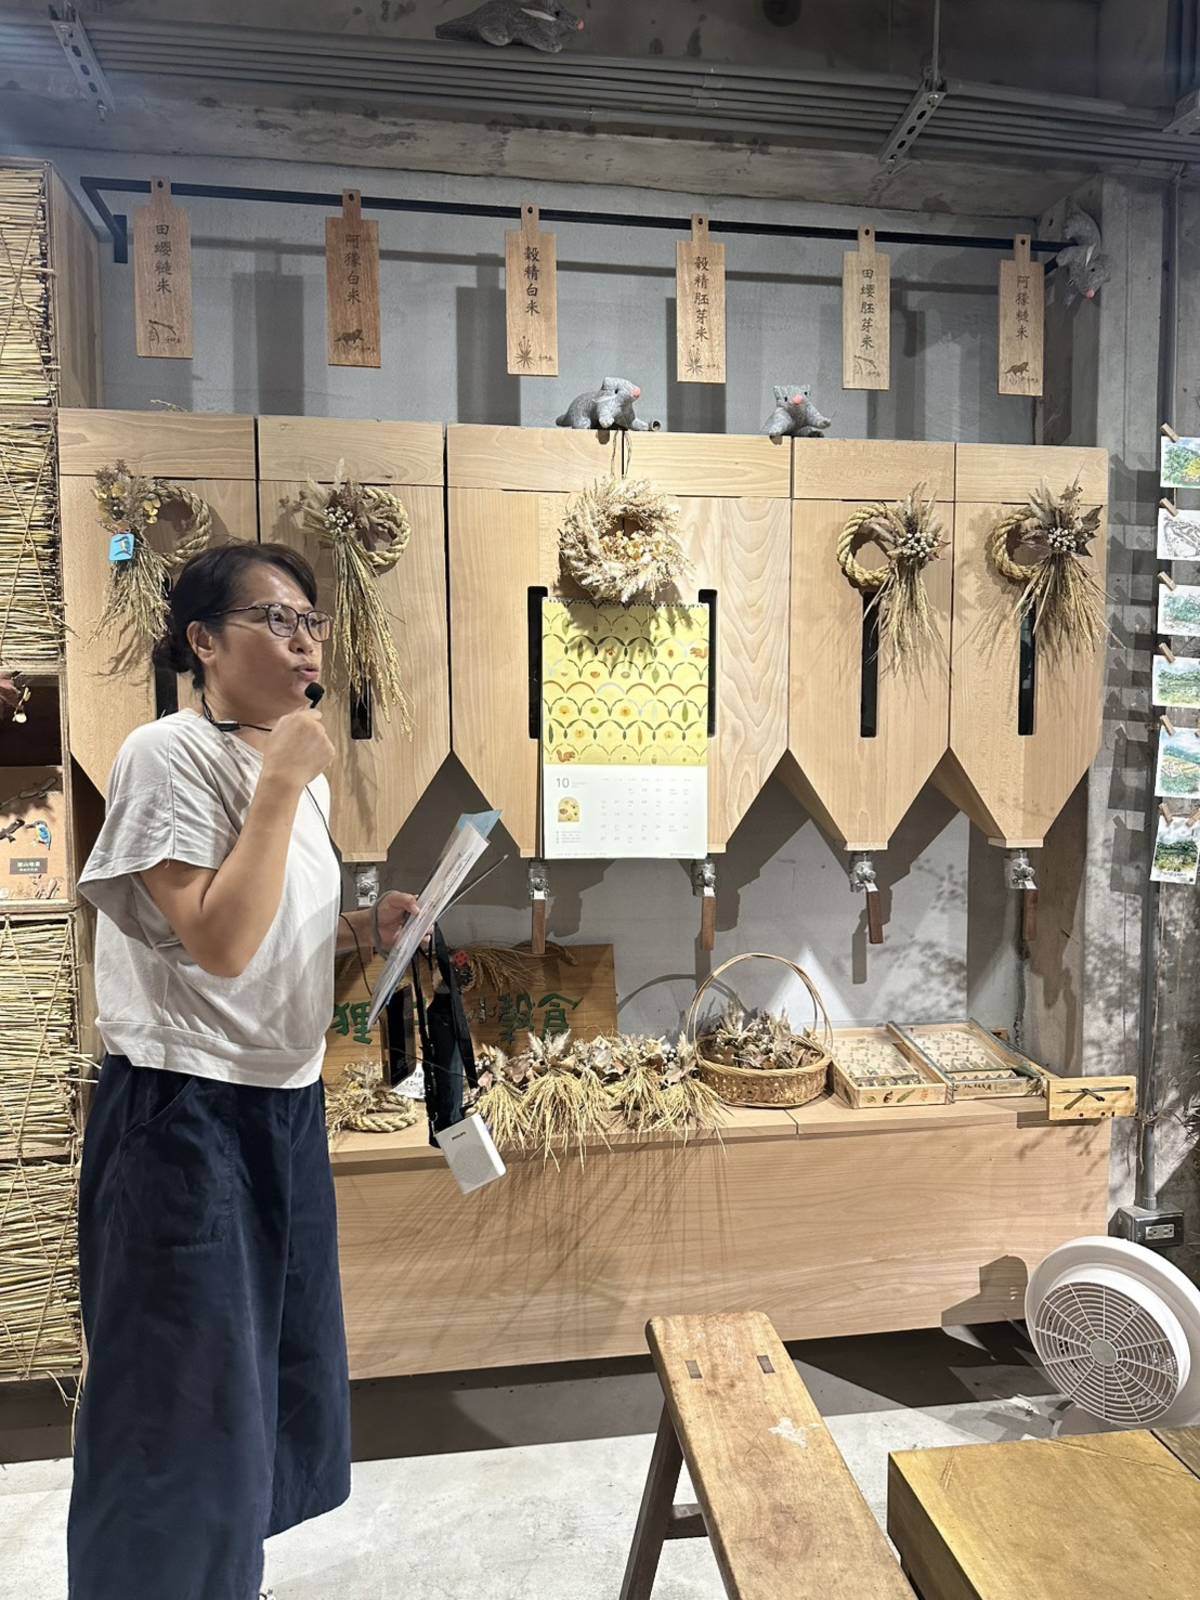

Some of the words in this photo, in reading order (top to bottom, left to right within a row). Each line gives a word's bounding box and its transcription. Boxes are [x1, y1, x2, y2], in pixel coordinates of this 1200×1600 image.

[523, 245, 541, 317] 穀精白米
[693, 255, 710, 342] 穀精胚芽米
[556, 777, 570, 789] 10
